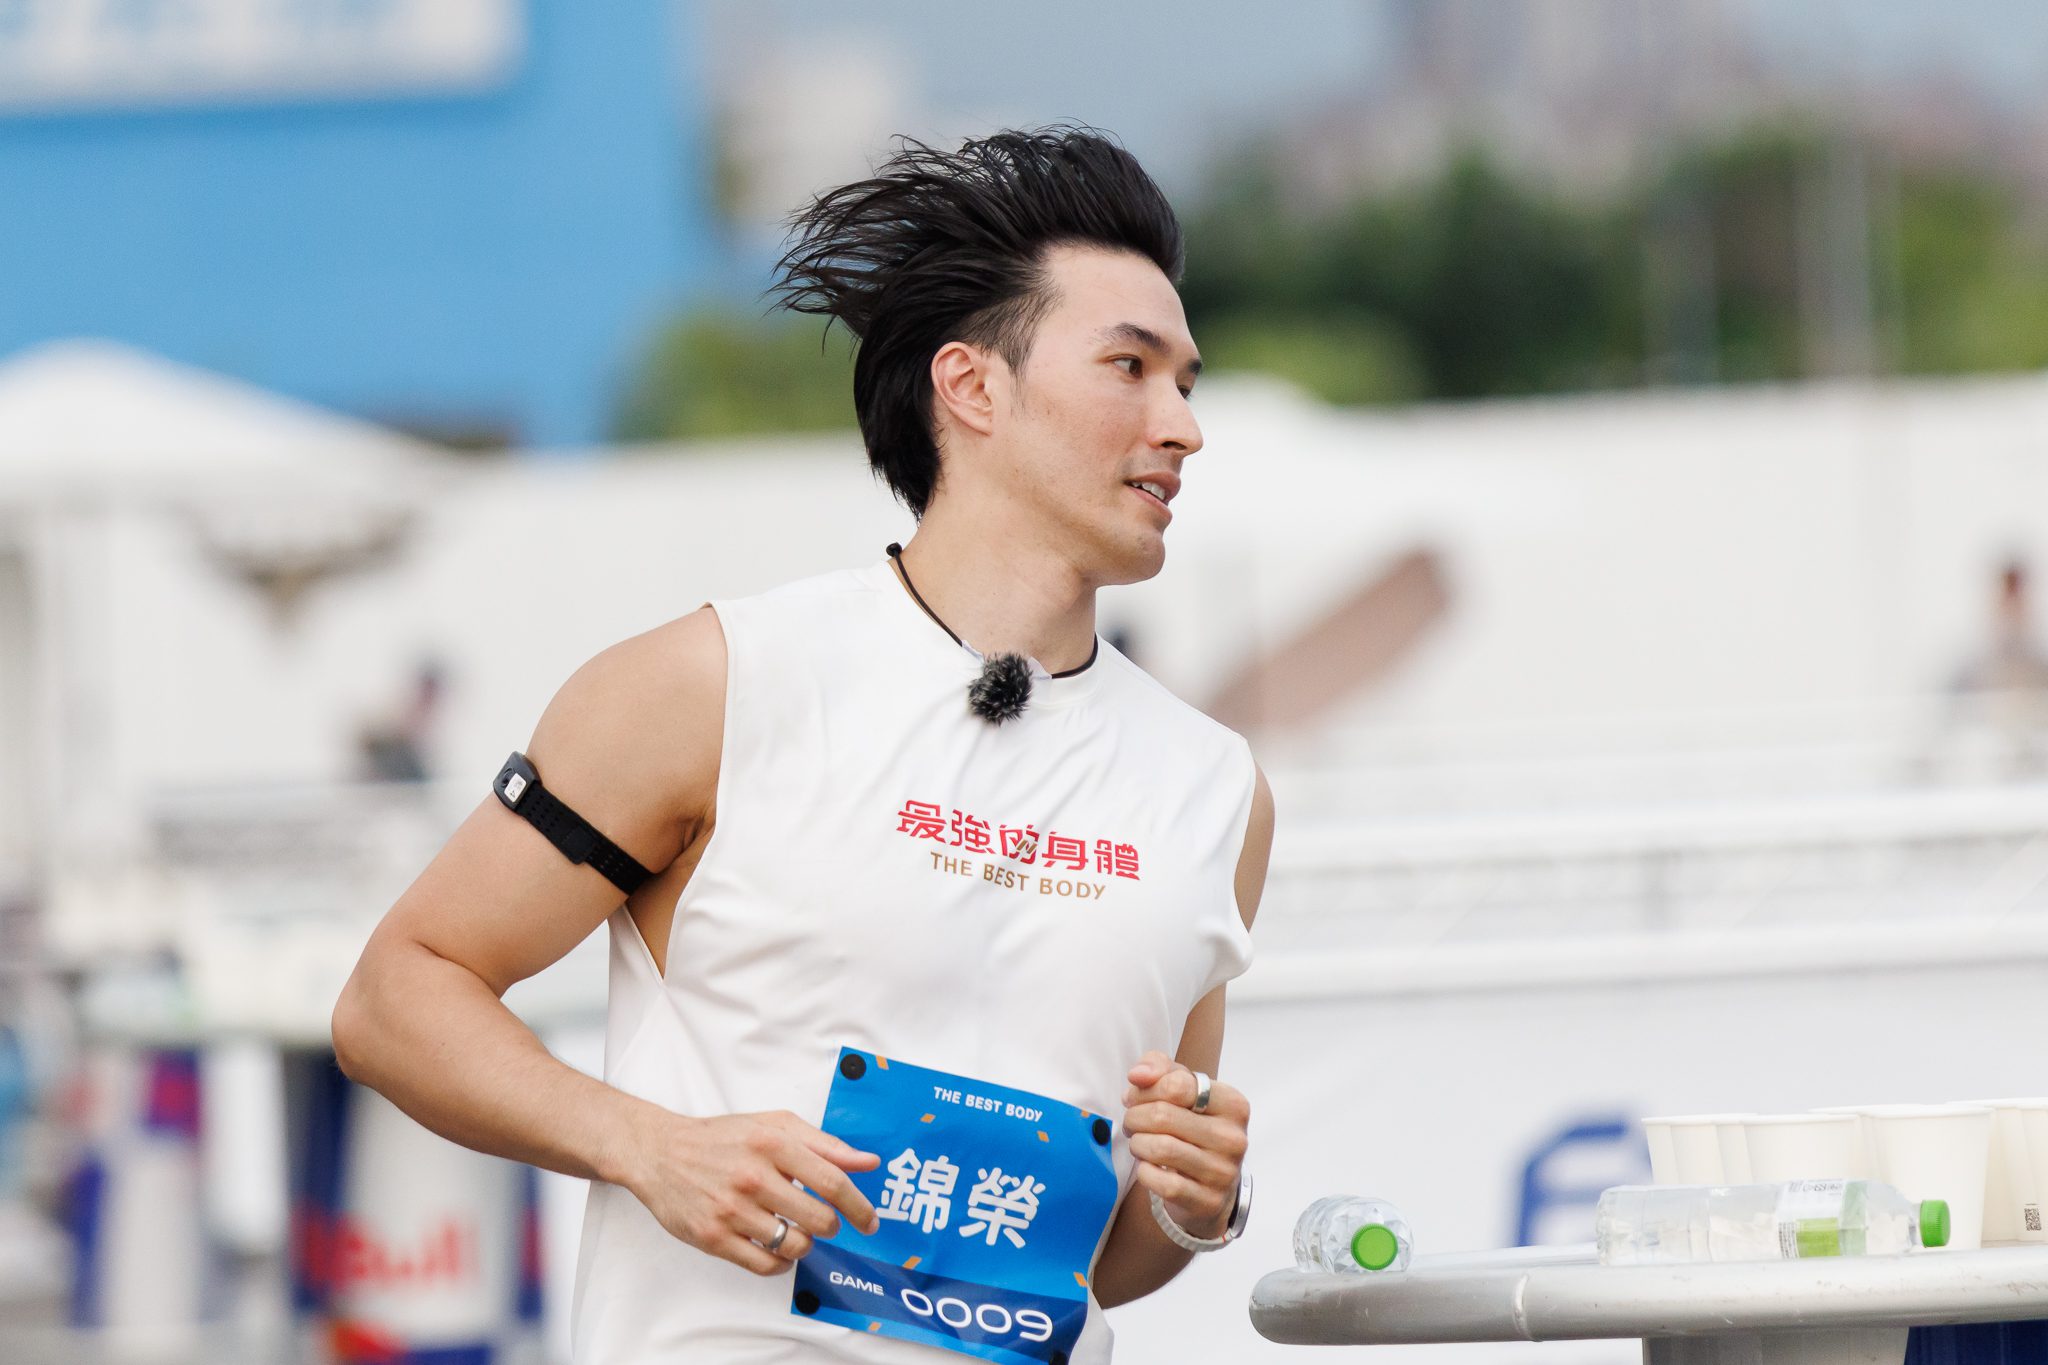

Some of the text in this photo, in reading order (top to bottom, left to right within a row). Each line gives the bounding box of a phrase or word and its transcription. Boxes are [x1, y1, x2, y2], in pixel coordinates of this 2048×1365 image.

[896, 799, 1141, 881] 最強的身體
[930, 851, 1107, 900] THE BEST BODY
[933, 1086, 1043, 1122] THE BEST BODY
[876, 1147, 1046, 1249] 錦榮
[829, 1271, 1053, 1343] GAME 0009
